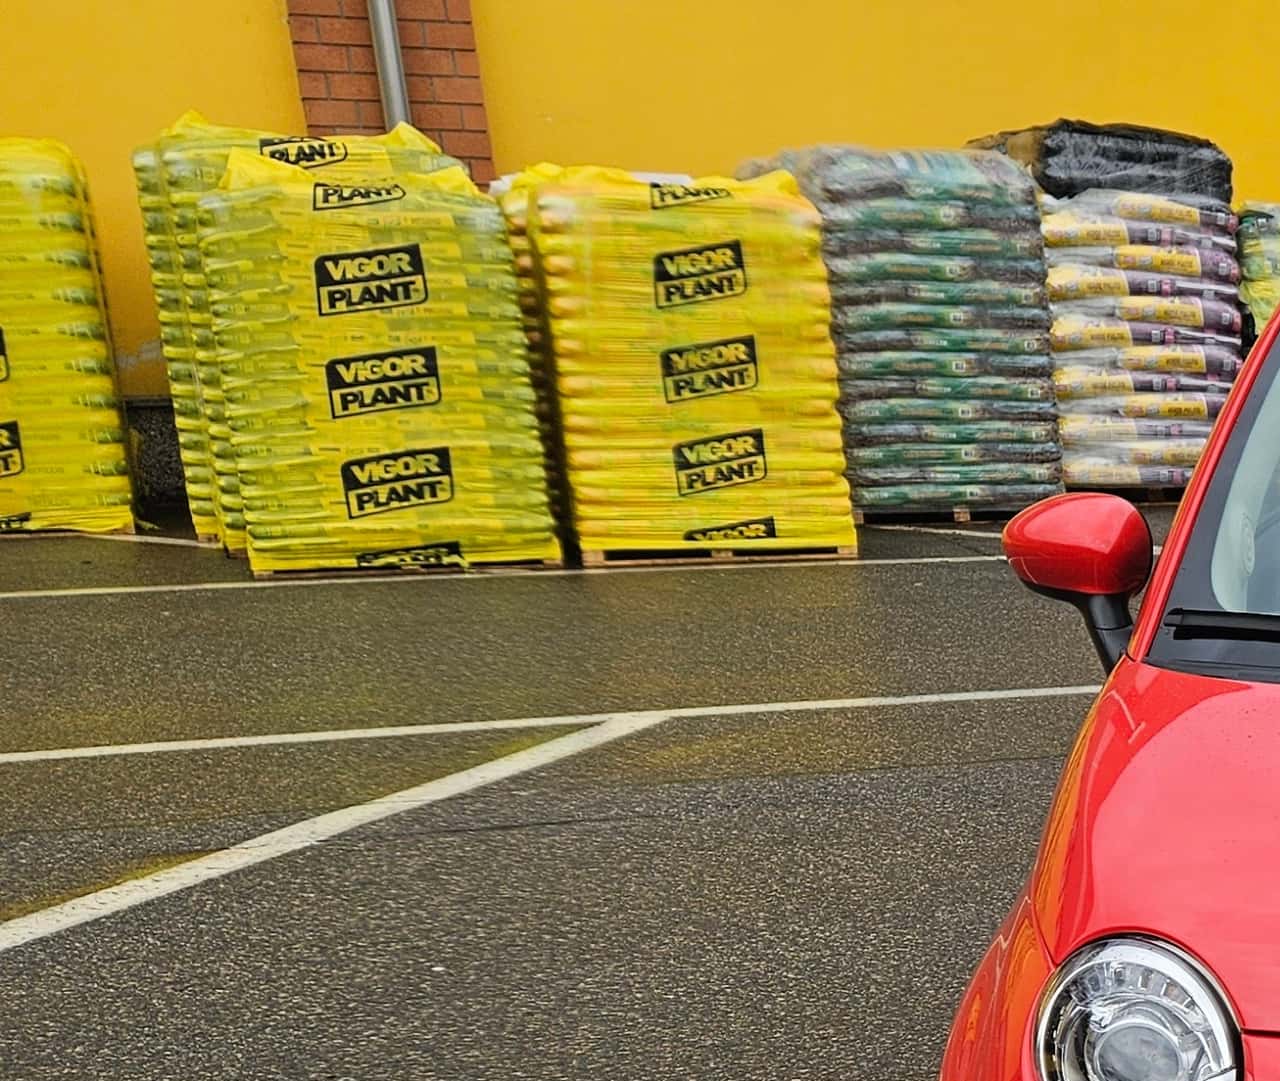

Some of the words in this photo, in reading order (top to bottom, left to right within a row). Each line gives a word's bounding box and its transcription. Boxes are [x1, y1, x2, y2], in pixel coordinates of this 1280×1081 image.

[322, 186, 394, 204] PLANT
[324, 252, 413, 281] VIGOR
[661, 248, 736, 276] VIGOR
[327, 281, 417, 309] PLANT
[664, 273, 736, 302] PLANT
[336, 354, 428, 383] VIGOR
[670, 343, 751, 371] VIGOR
[673, 367, 748, 396] PLANT
[340, 382, 431, 411] PLANT
[681, 436, 757, 464] VIGOR
[351, 453, 441, 484] VIGOR
[686, 459, 758, 489] PLANT
[355, 480, 443, 511] PLANT
